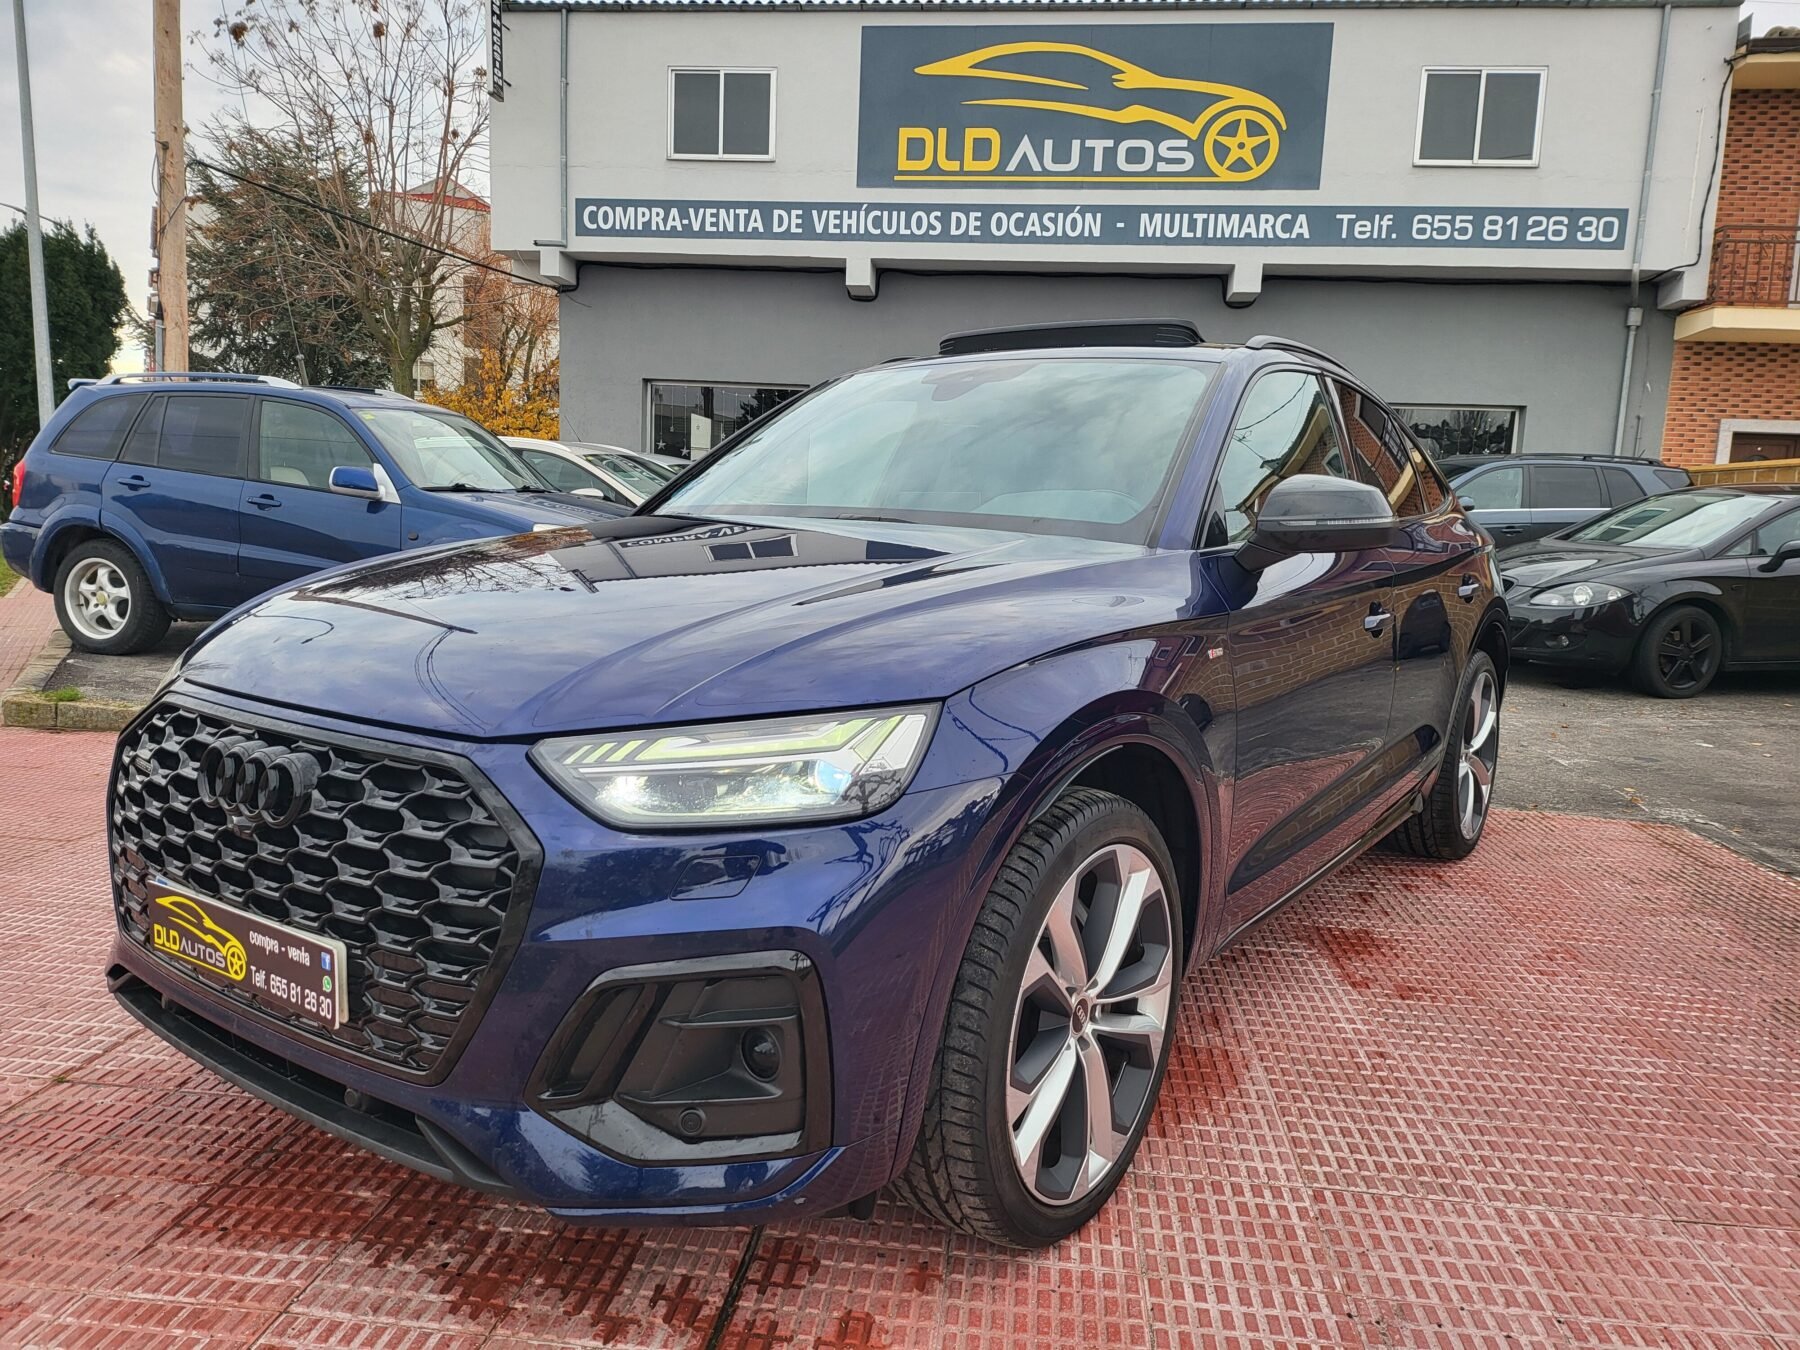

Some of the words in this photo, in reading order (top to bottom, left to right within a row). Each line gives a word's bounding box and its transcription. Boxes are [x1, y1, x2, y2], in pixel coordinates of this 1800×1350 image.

[1005, 134, 1195, 173] AUTOS
[583, 205, 764, 232] COMPRA-VENTA
[772, 209, 803, 233] DE
[811, 204, 942, 236] VEHÍCULOS
[950, 211, 981, 236] DE
[990, 206, 1102, 237] OCASIÓN
[1139, 213, 1310, 239] MULTIMARCA
[1336, 214, 1397, 239] Telf.
[1411, 214, 1473, 240] 655
[1482, 215, 1519, 241] 81
[1526, 215, 1569, 242] 26
[1576, 216, 1619, 242] 30
[180, 937, 226, 969] AUTOS
[249, 930, 279, 956] compra
[287, 946, 310, 967] venta
[250, 965, 267, 991] Telf.
[270, 973, 288, 999] 655
[290, 983, 301, 1005] 81
[304, 989, 318, 1013] 26
[319, 998, 332, 1019] 30
